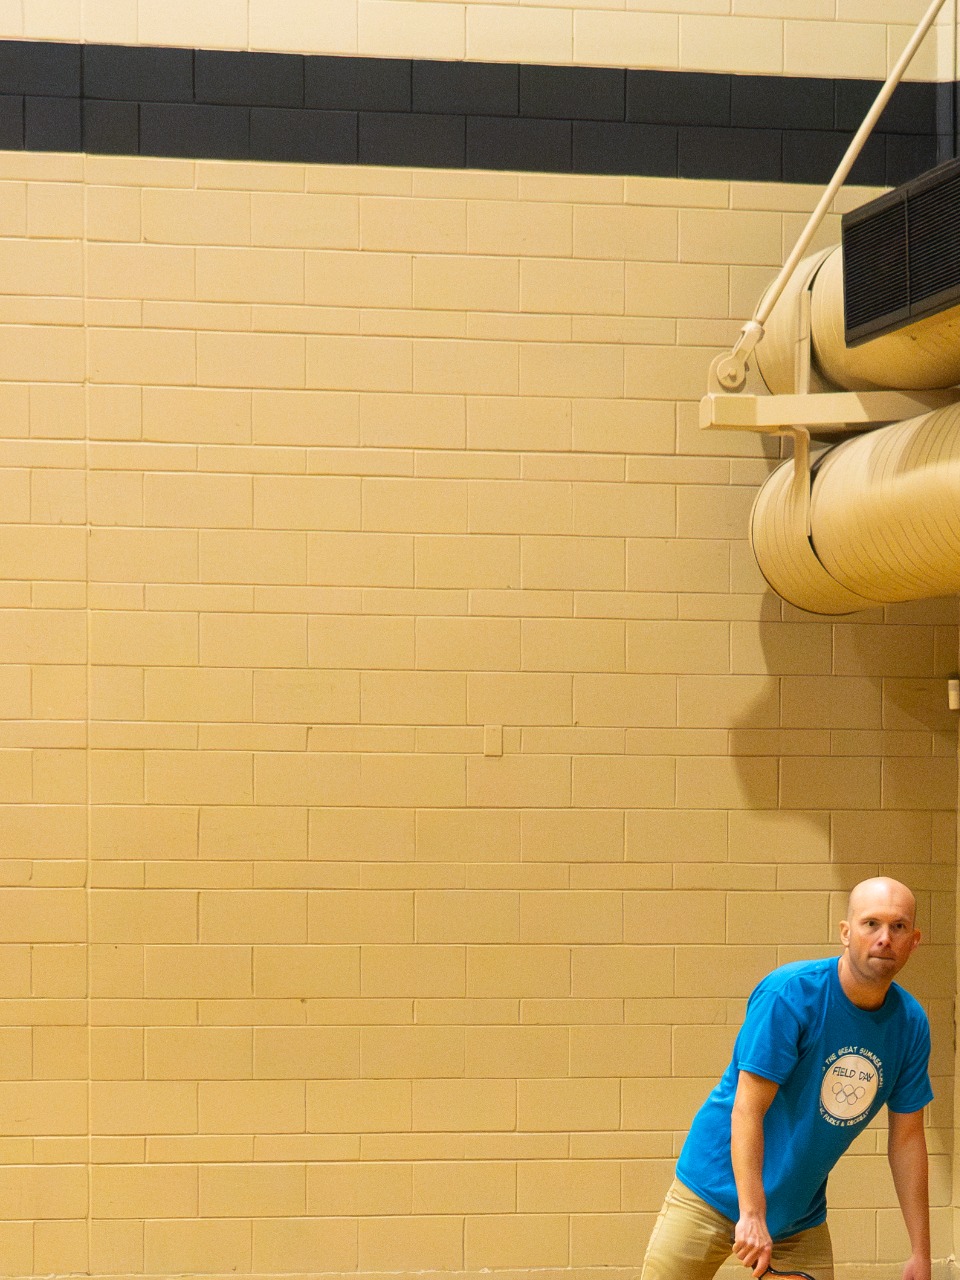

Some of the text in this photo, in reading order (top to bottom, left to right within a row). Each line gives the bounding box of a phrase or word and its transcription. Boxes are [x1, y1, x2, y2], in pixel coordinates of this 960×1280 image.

[825, 1046, 883, 1068] THE GREAT SUMMER
[832, 1066, 856, 1079] FIELD
[858, 1071, 875, 1083] DAY
